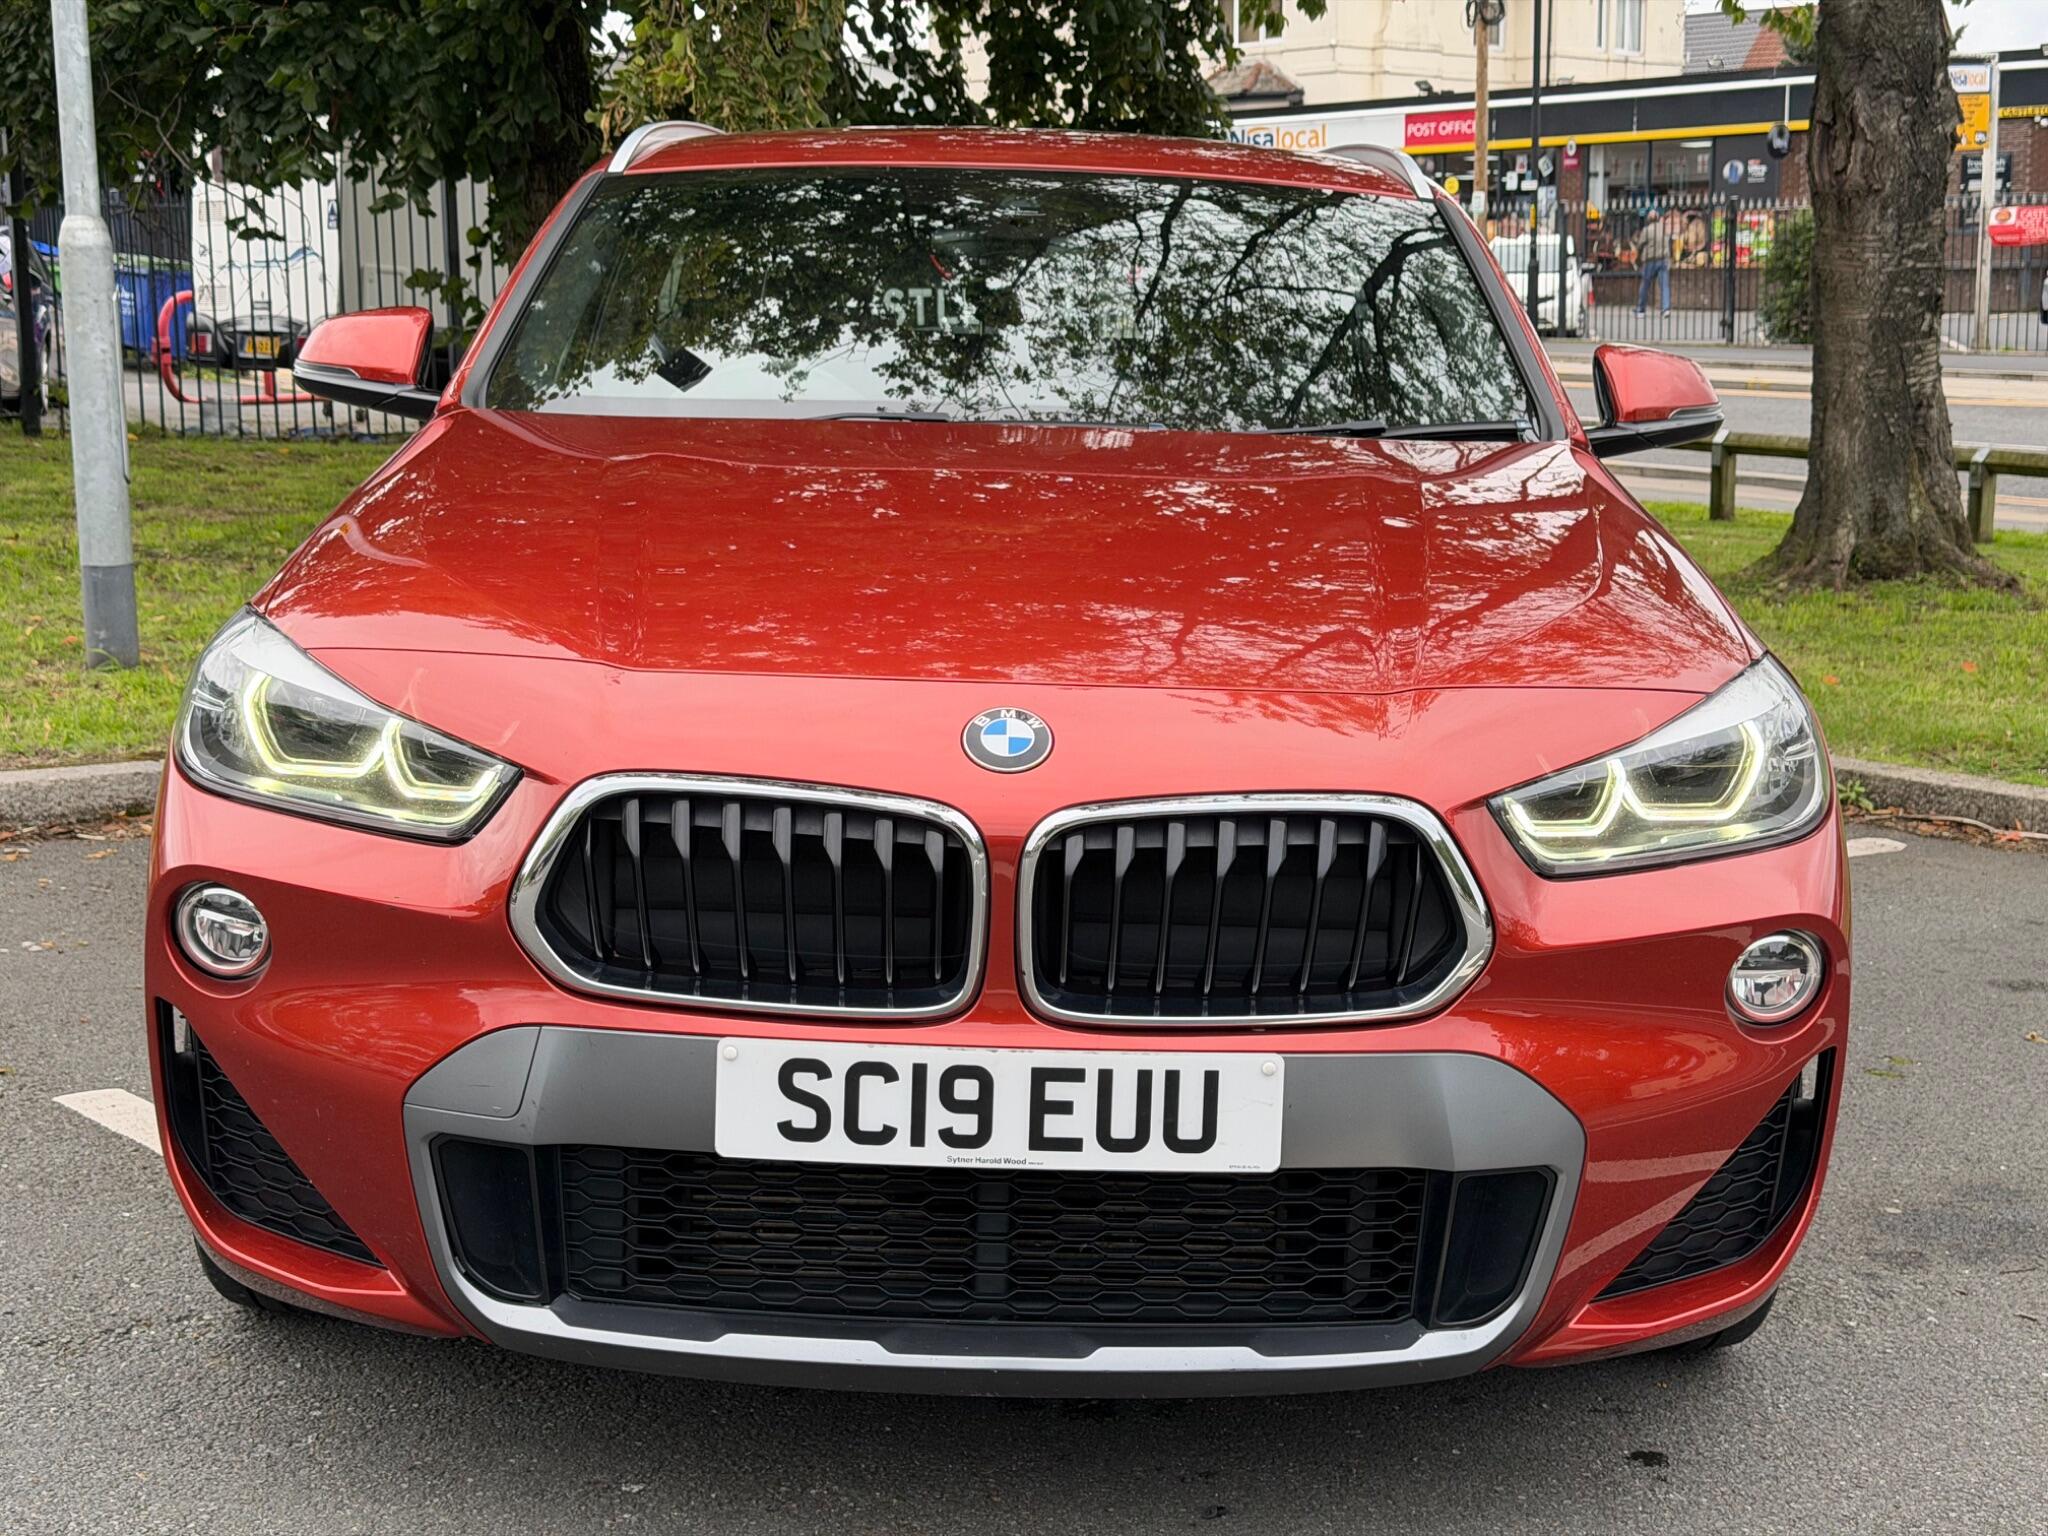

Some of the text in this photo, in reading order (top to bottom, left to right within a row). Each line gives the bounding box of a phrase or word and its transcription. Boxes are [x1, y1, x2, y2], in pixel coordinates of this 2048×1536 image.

[1407, 122, 1438, 137] POST
[973, 709, 1044, 730] BMW
[776, 1057, 1221, 1155] SC19 EUU
[946, 1155, 974, 1165] Sytner
[975, 1156, 1002, 1165] Harold
[1003, 1157, 1027, 1166] Wood
